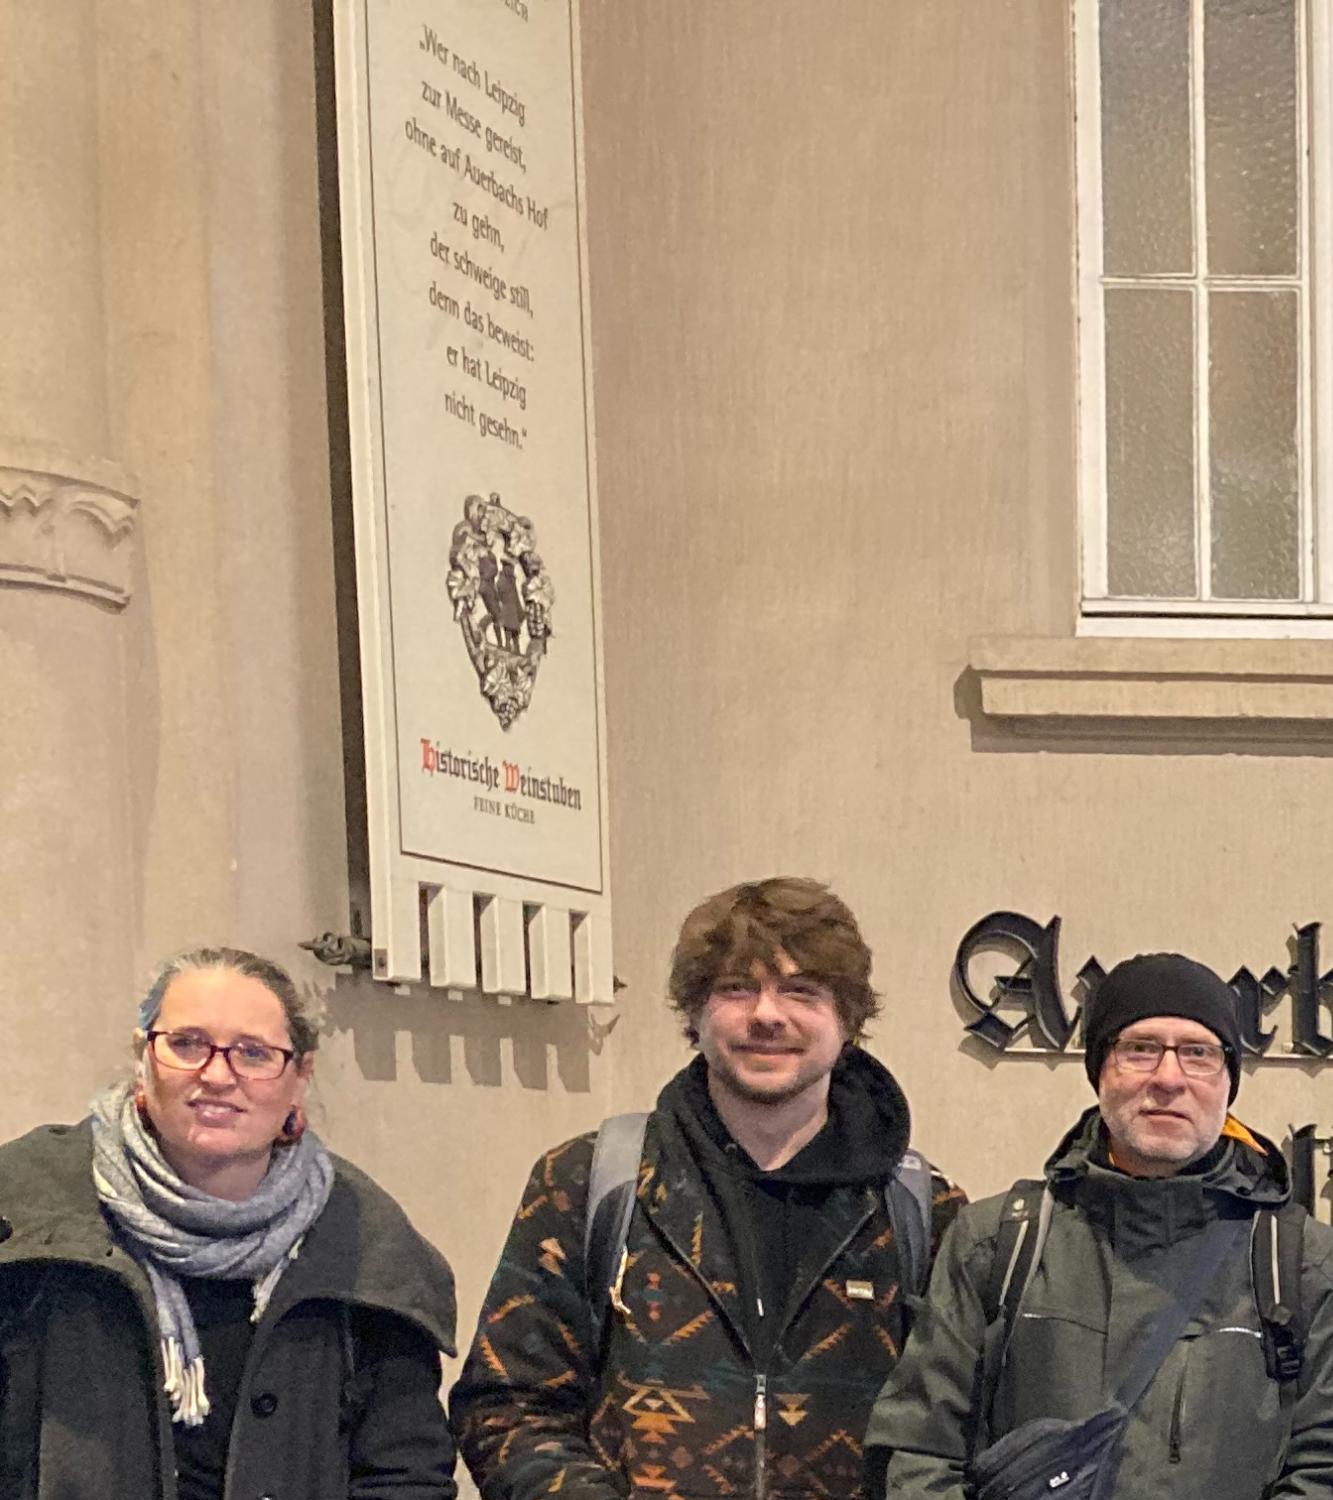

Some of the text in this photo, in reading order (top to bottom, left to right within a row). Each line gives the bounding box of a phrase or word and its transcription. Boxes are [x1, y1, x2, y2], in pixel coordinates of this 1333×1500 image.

[420, 80, 442, 109] zur
[445, 89, 481, 139] Messe
[452, 52, 481, 89] nach
[484, 70, 526, 127] Leipzig
[404, 116, 549, 230] ohne auf Auerbachs Hof
[452, 201, 469, 226] zu
[430, 231, 450, 265] der
[453, 249, 507, 301] schweige
[429, 280, 460, 320] denn
[464, 301, 485, 333] das
[444, 390, 476, 427] nicht
[446, 345, 527, 410] er hat Leipzig
[420, 738, 582, 811] Historische Weinstuben
[473, 796, 536, 825] FEINE KÜCHE
